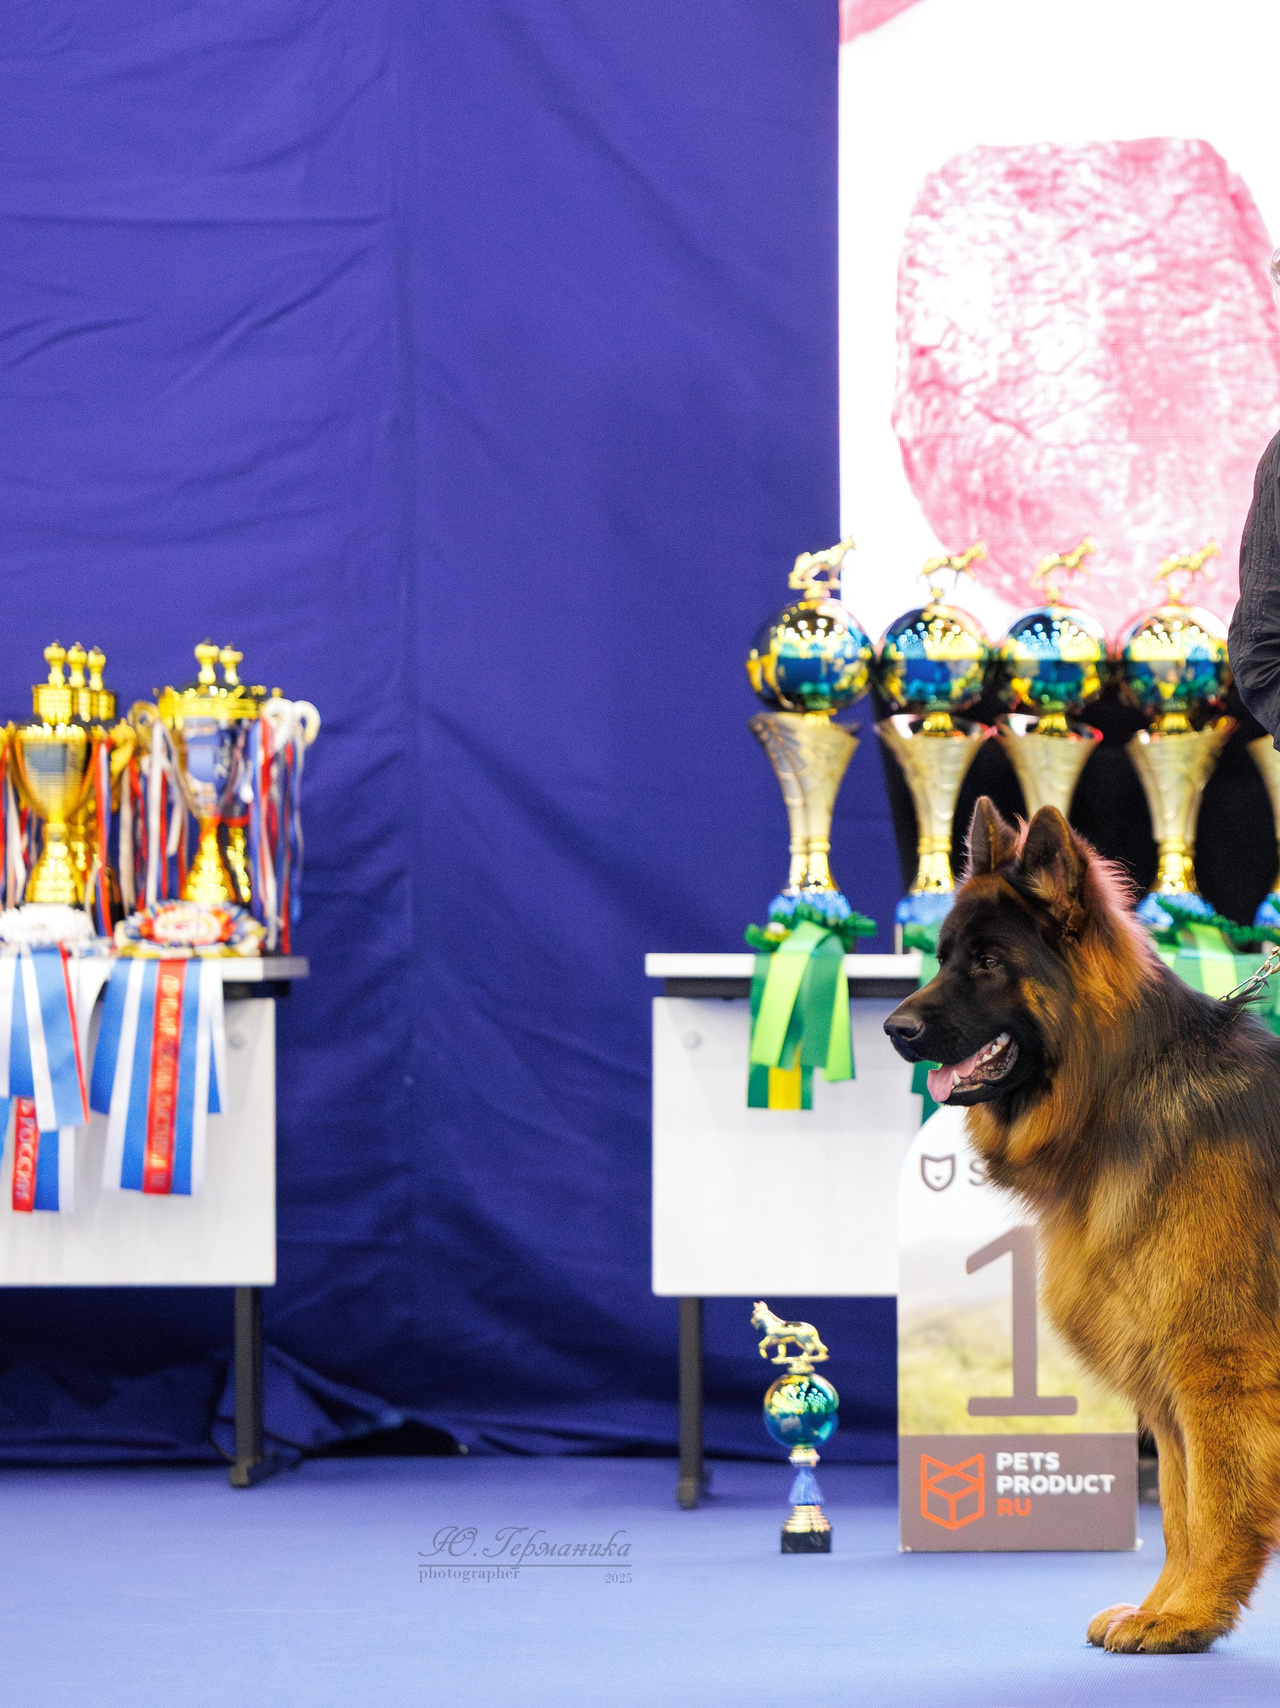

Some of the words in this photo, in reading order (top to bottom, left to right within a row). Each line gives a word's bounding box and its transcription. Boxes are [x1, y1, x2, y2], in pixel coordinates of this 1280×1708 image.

[966, 1225, 1078, 1416] 1
[996, 1451, 1061, 1472] PETS
[996, 1474, 1116, 1495] PRODUCT
[997, 1498, 1032, 1517] RU
